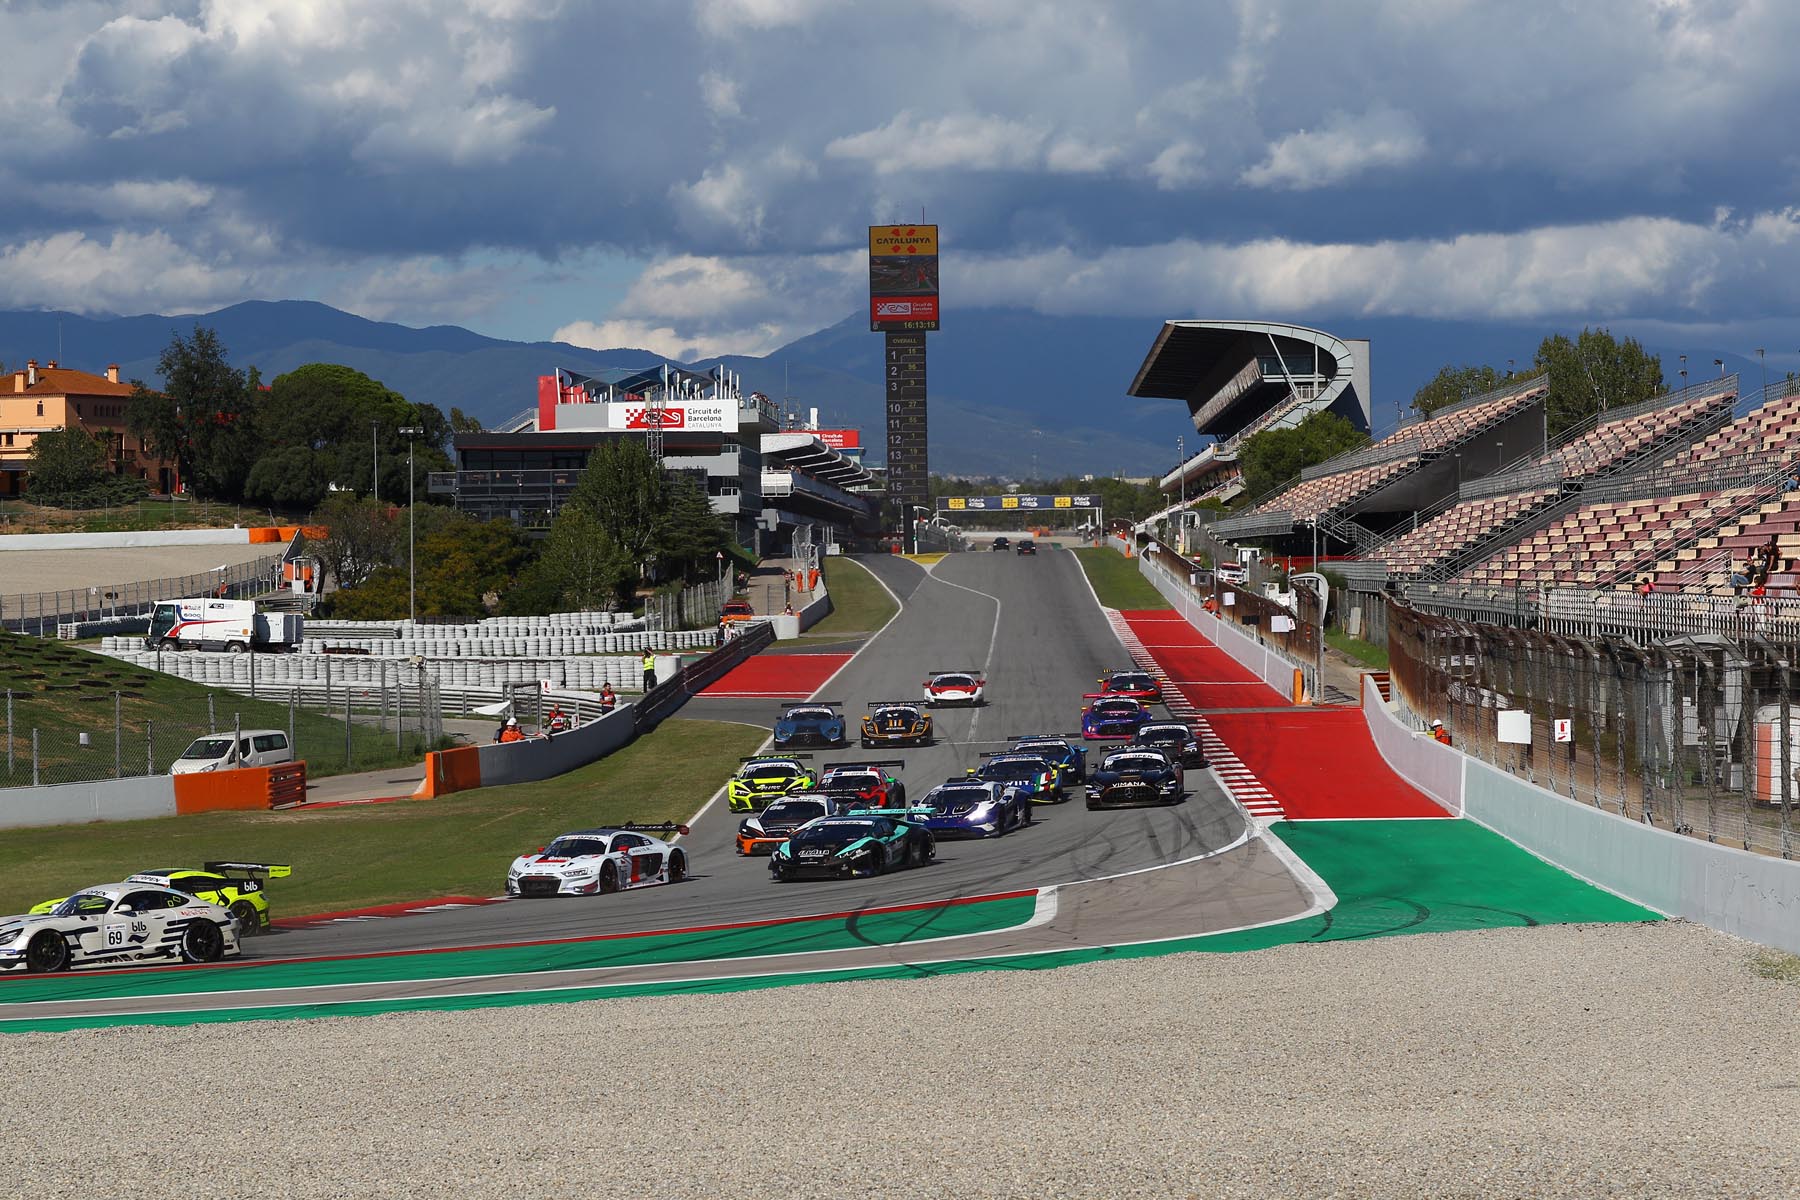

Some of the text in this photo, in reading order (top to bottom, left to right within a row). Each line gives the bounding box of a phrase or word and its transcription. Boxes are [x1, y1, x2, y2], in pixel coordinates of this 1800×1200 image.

[904, 321, 936, 329] 16:13:19
[891, 351, 896, 360] 1
[891, 366, 897, 376] 2
[891, 382, 897, 391] 3
[889, 403, 901, 413] 10
[889, 420, 900, 429] 11
[890, 435, 902, 444] 12
[890, 451, 902, 460] 13
[890, 466, 902, 476] 14
[891, 482, 902, 491] 15
[243, 881, 258, 892] blb
[131, 921, 147, 932] blb
[108, 931, 123, 945] 69
